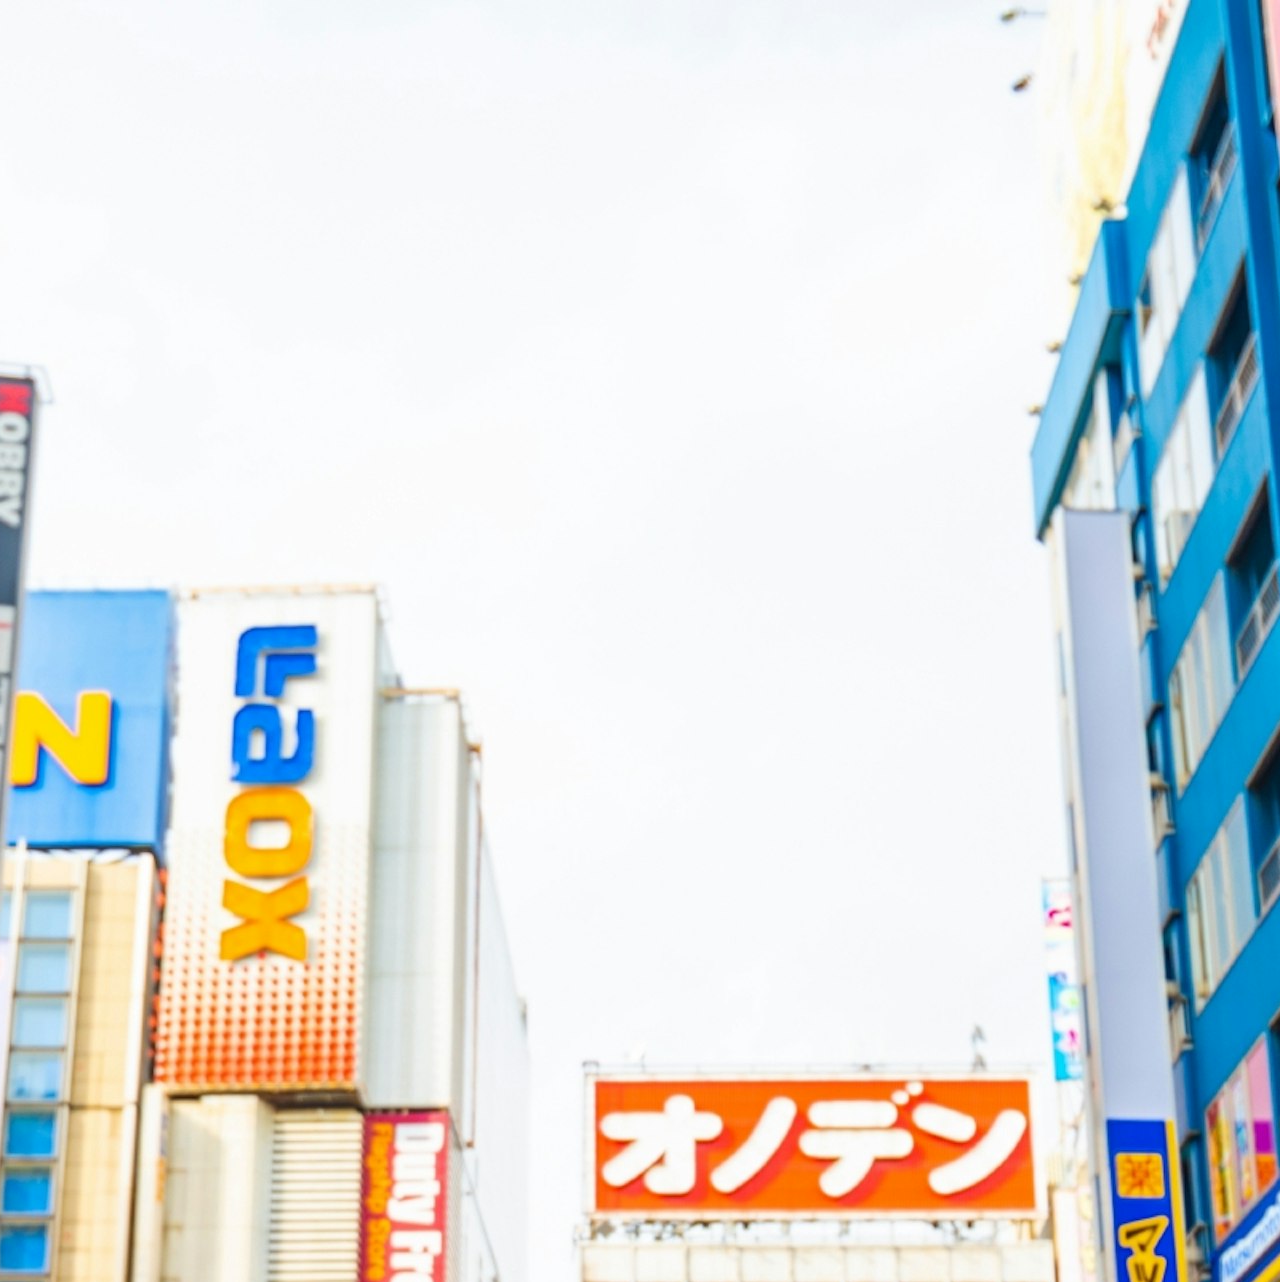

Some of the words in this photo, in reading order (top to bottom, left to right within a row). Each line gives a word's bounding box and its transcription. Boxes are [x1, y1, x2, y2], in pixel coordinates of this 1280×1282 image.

[387, 1122, 445, 1226] Duty
[600, 1079, 1028, 1198] オノデン
